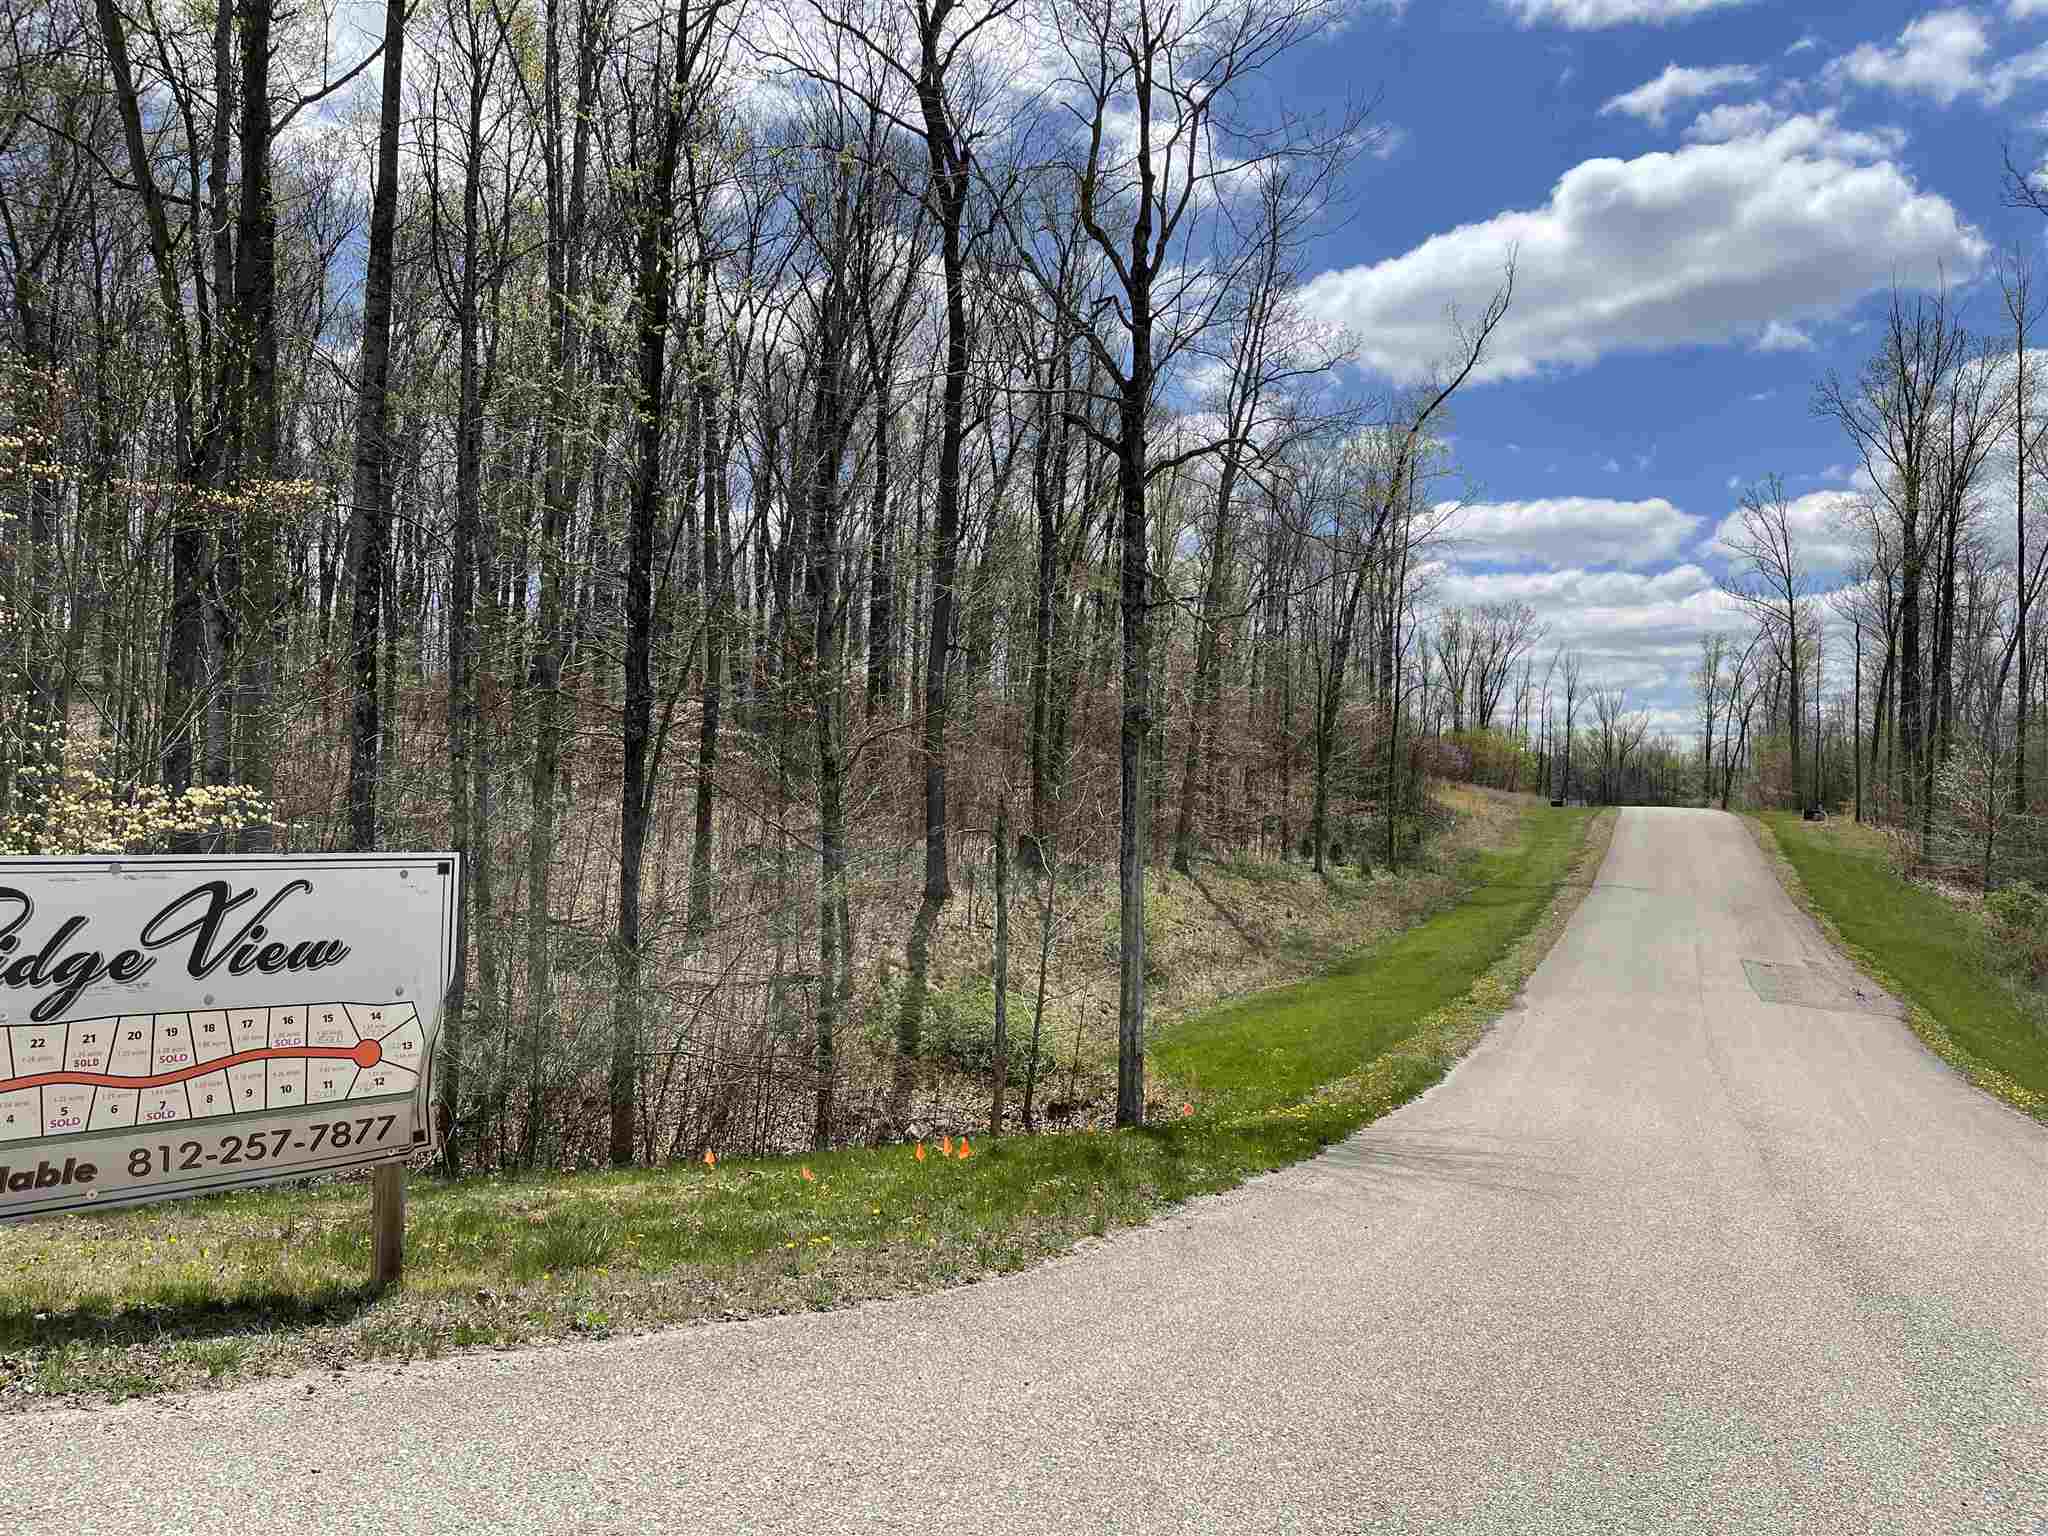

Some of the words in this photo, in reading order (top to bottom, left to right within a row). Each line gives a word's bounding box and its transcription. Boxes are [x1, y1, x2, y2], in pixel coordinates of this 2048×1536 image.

[141, 879, 351, 981] View
[283, 1016, 294, 1025] 16
[322, 1014, 333, 1023] 15
[371, 1012, 382, 1020] 14
[203, 1024, 215, 1033] 18
[242, 1019, 254, 1029] 17
[127, 1031, 142, 1040] 20
[165, 1027, 178, 1037] 19
[30, 1038, 46, 1048] 22
[82, 1034, 96, 1044] 21
[274, 1039, 302, 1048] SOLD
[402, 1041, 413, 1050] 13
[73, 1058, 99, 1067] SOLD
[159, 1054, 188, 1064] SOLD
[323, 1080, 333, 1089] 11
[374, 1077, 385, 1086] 12
[245, 1089, 253, 1098] 9
[281, 1085, 292, 1094] 10
[206, 1095, 213, 1103] 8
[110, 1105, 118, 1114] 6
[159, 1101, 167, 1110] 7
[61, 1106, 68, 1116] 5
[146, 1111, 176, 1120] SOLD
[6, 1115, 14, 1123] 4
[49, 1117, 81, 1129] SOLD
[127, 1115, 397, 1179] 812-257-7877
